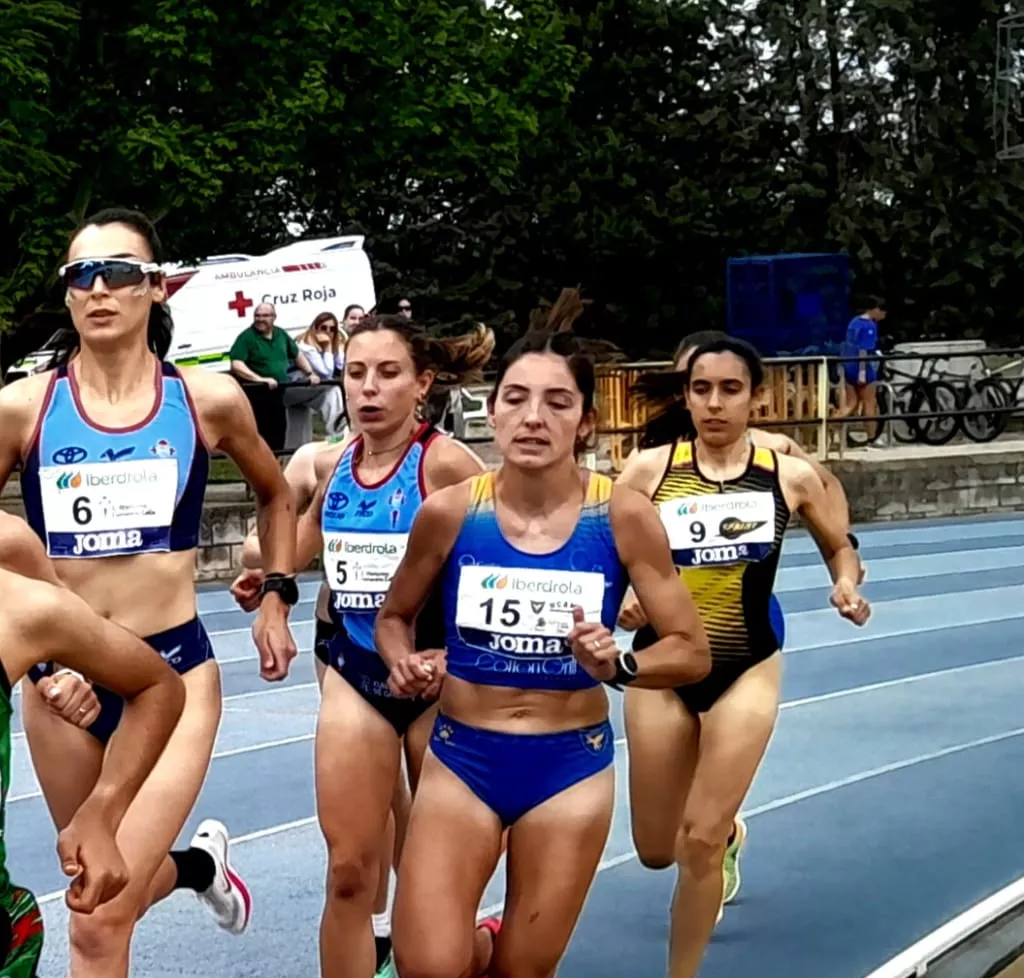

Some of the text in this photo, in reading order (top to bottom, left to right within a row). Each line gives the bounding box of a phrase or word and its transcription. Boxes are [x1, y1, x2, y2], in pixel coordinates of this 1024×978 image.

[214, 267, 281, 281] AMBULANCIA
[261, 285, 337, 306] Cruz Roja
[86, 471, 158, 487] Iberdrola
[72, 496, 93, 525] 6
[689, 521, 706, 543] 9
[336, 560, 347, 585] 5
[511, 576, 583, 596] Iberdrola
[479, 597, 521, 628] 15
